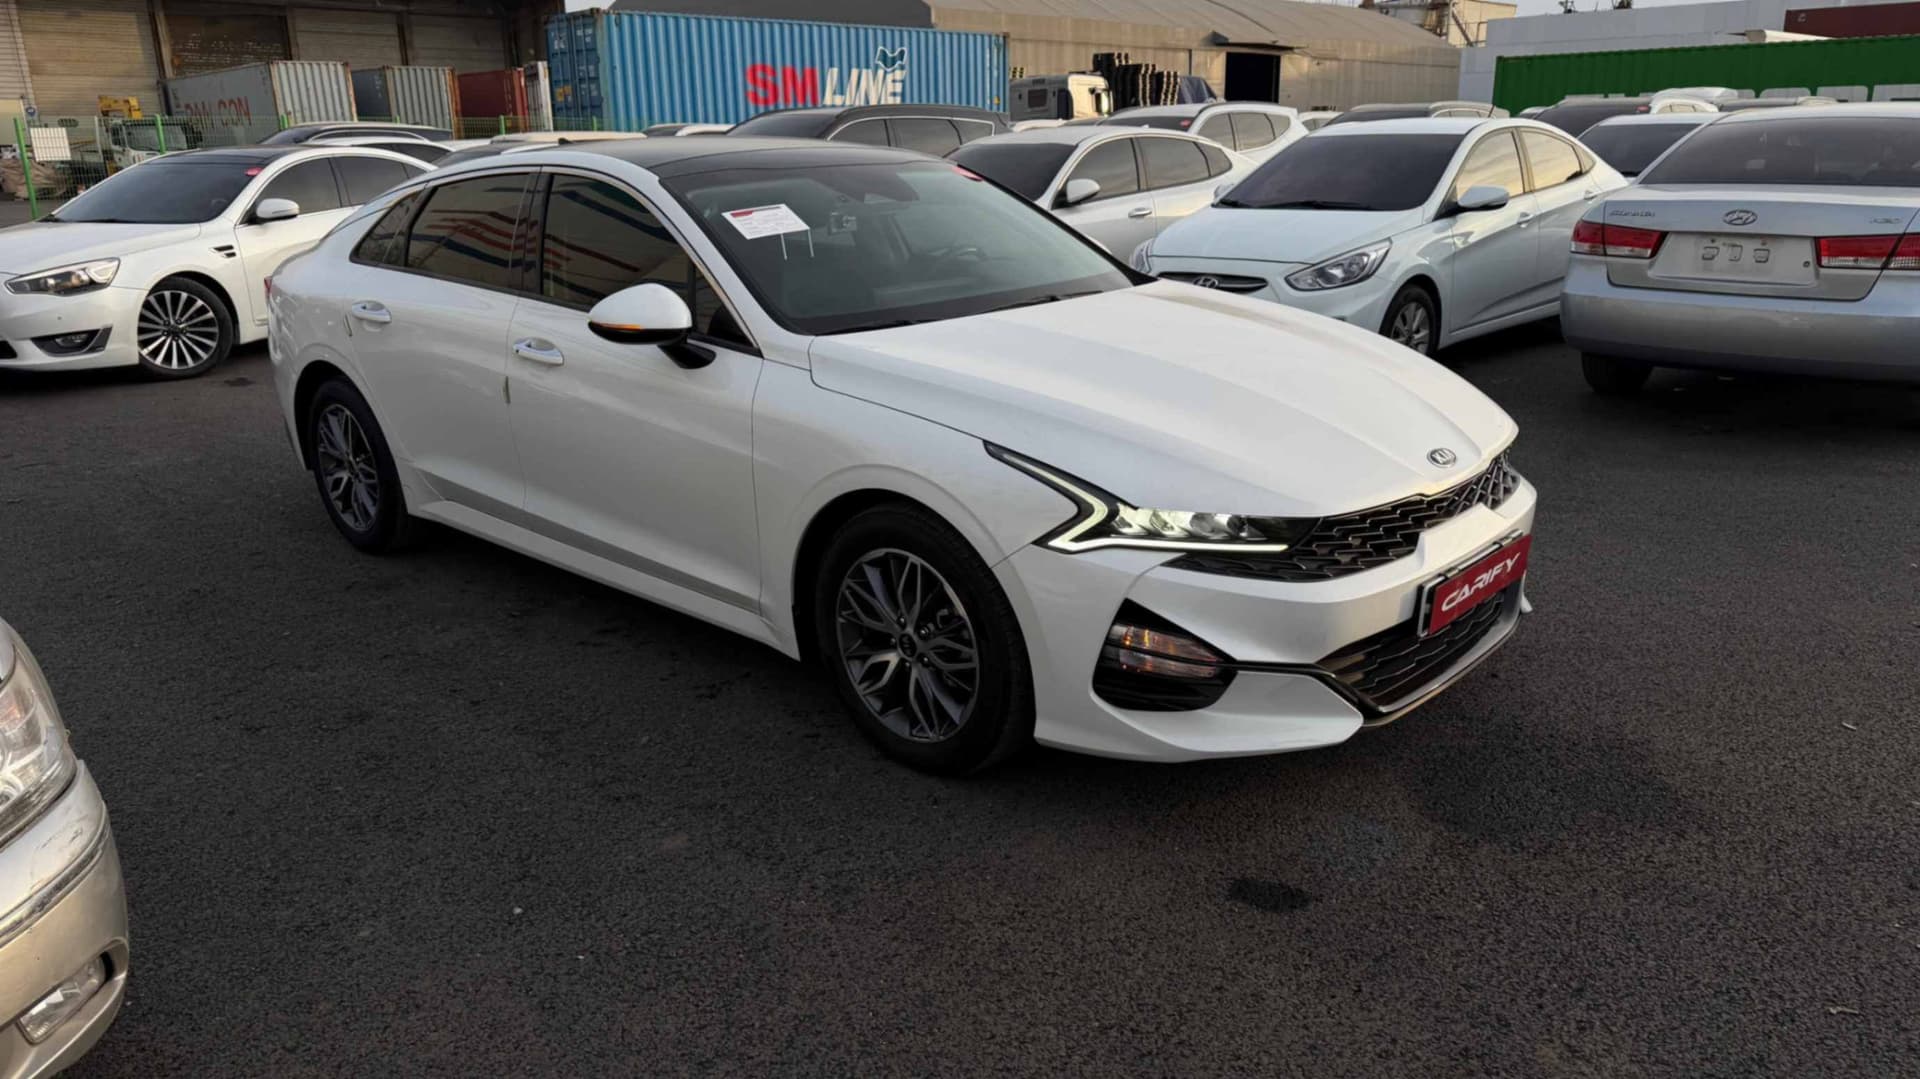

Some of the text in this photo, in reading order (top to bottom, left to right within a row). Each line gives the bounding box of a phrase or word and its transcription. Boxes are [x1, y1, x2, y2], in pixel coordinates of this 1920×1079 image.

[745, 63, 907, 107] SM LINE
[1441, 552, 1521, 612] CARIFY
